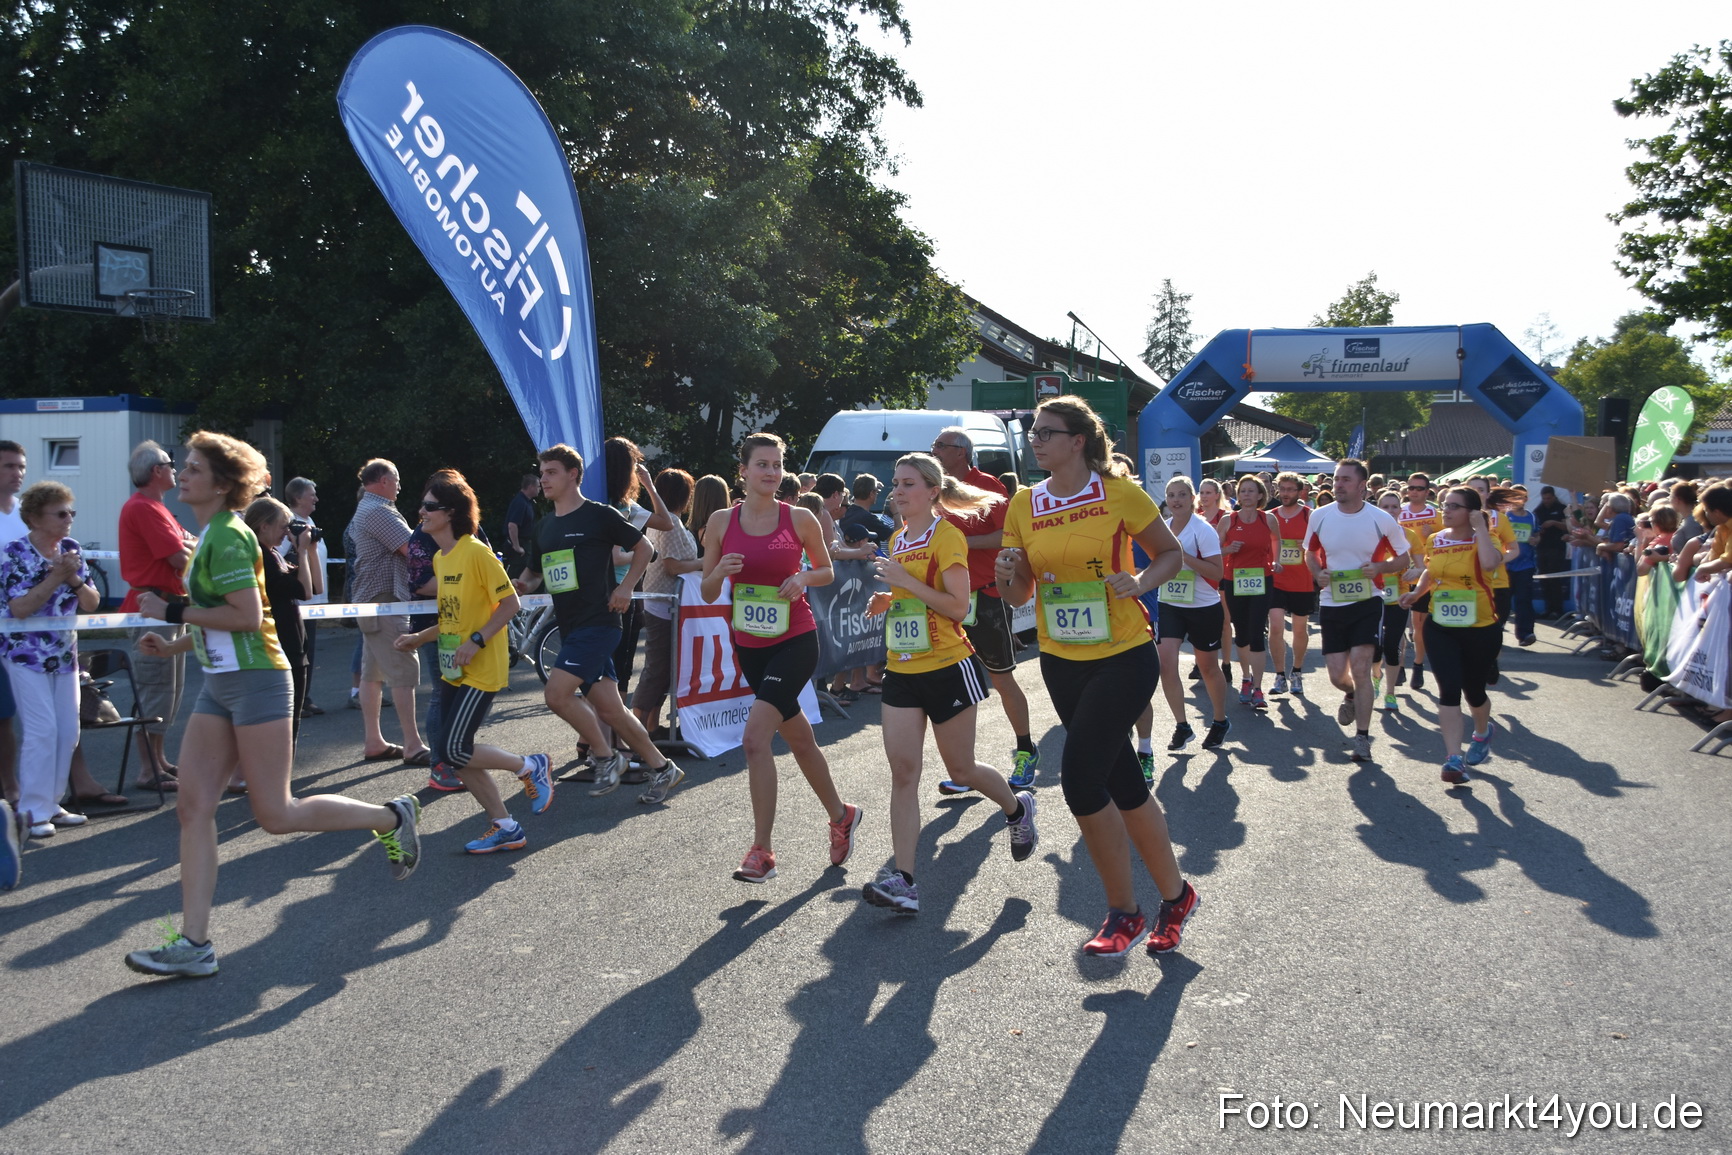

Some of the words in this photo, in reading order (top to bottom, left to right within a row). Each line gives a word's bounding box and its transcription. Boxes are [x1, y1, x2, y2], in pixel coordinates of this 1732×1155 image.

[1331, 357, 1410, 373] firmenlauf
[1186, 388, 1226, 397] Fischer
[1631, 440, 1662, 471] AOK
[1032, 516, 1064, 532] MAX
[1070, 506, 1109, 523] BÖGL
[768, 542, 798, 550] adidas
[904, 552, 929, 563] BÖGL
[1282, 549, 1300, 558] 373
[548, 566, 568, 582] 105
[1167, 582, 1188, 594] 827
[1237, 578, 1262, 588] 1362
[1338, 582, 1363, 594] 826
[744, 605, 778, 624] 908
[1441, 604, 1468, 616] 909
[1056, 607, 1092, 628] 871
[894, 620, 919, 638] 918
[847, 636, 883, 655] AUTOMOBILE
